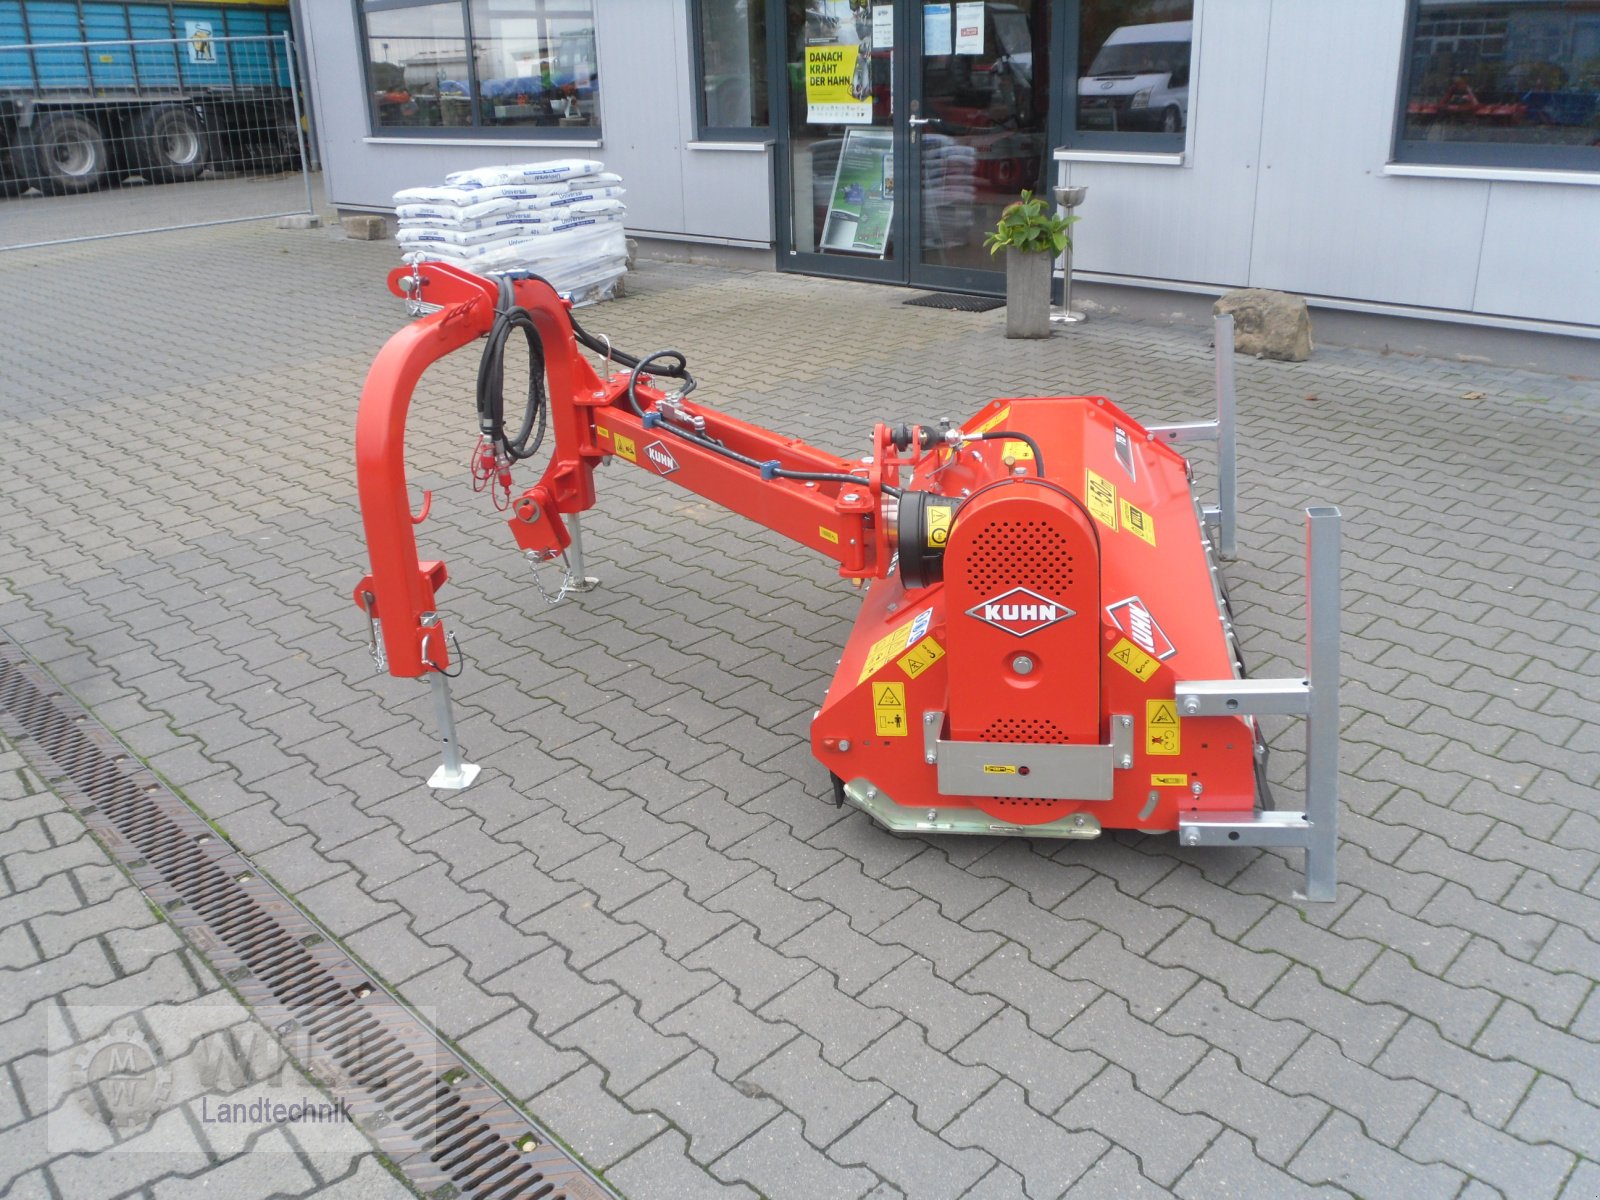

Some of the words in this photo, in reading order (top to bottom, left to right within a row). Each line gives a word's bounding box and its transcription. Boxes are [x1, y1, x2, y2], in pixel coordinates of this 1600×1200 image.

[810, 52, 842, 62] DANACH
[810, 63, 837, 74] KRÄHT
[810, 77, 825, 86] DER
[827, 76, 850, 86] HAHN
[649, 447, 673, 469] KUHN
[985, 604, 1056, 621] KUHN
